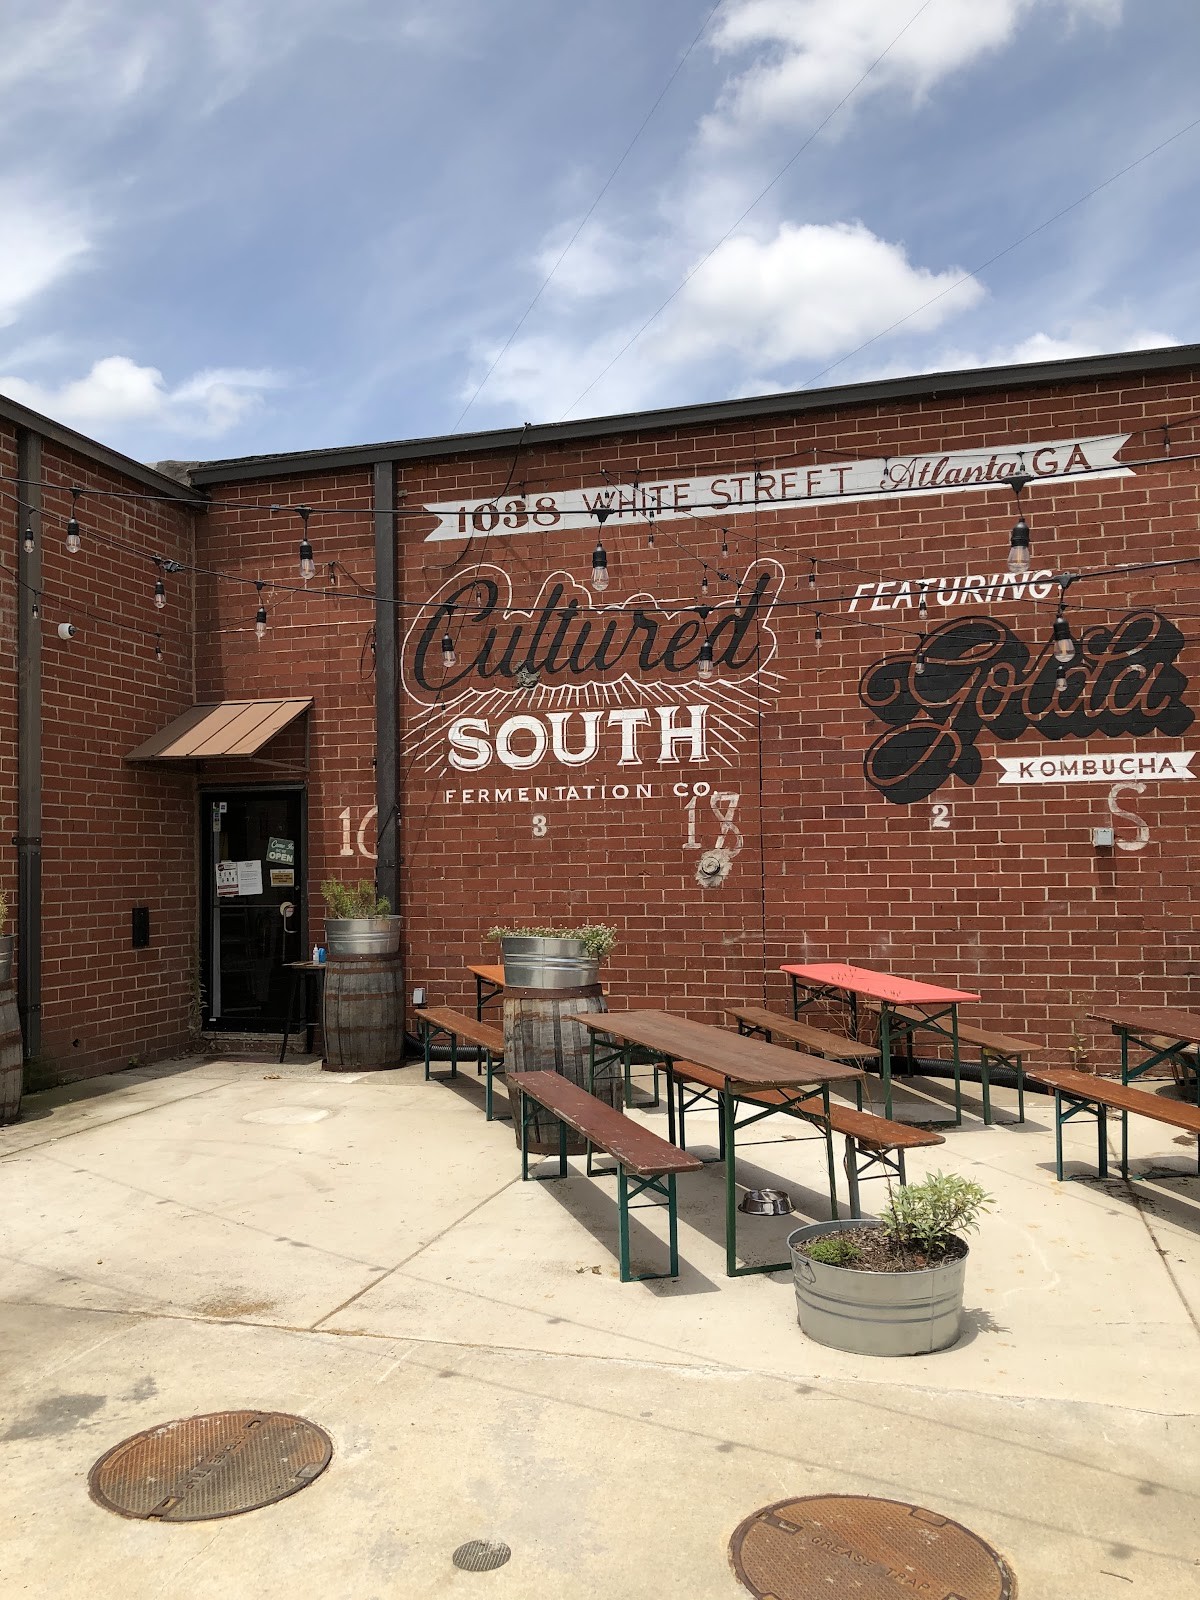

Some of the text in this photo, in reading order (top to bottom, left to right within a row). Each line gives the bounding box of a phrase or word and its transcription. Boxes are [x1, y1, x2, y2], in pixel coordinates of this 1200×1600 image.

[458, 443, 1092, 533] 1038 WHITE STREET Atlanta GA
[414, 572, 771, 692] Cultured
[860, 609, 1187, 796] Golda
[448, 704, 711, 772] SOUTH
[1019, 756, 1177, 779] KOMBUCHA
[445, 783, 653, 803] FERMENTATION
[532, 814, 547, 837] 3
[932, 804, 951, 829] 2
[269, 851, 293, 863] OPEN
[811, 1535, 933, 1592] GREASE TRAP
